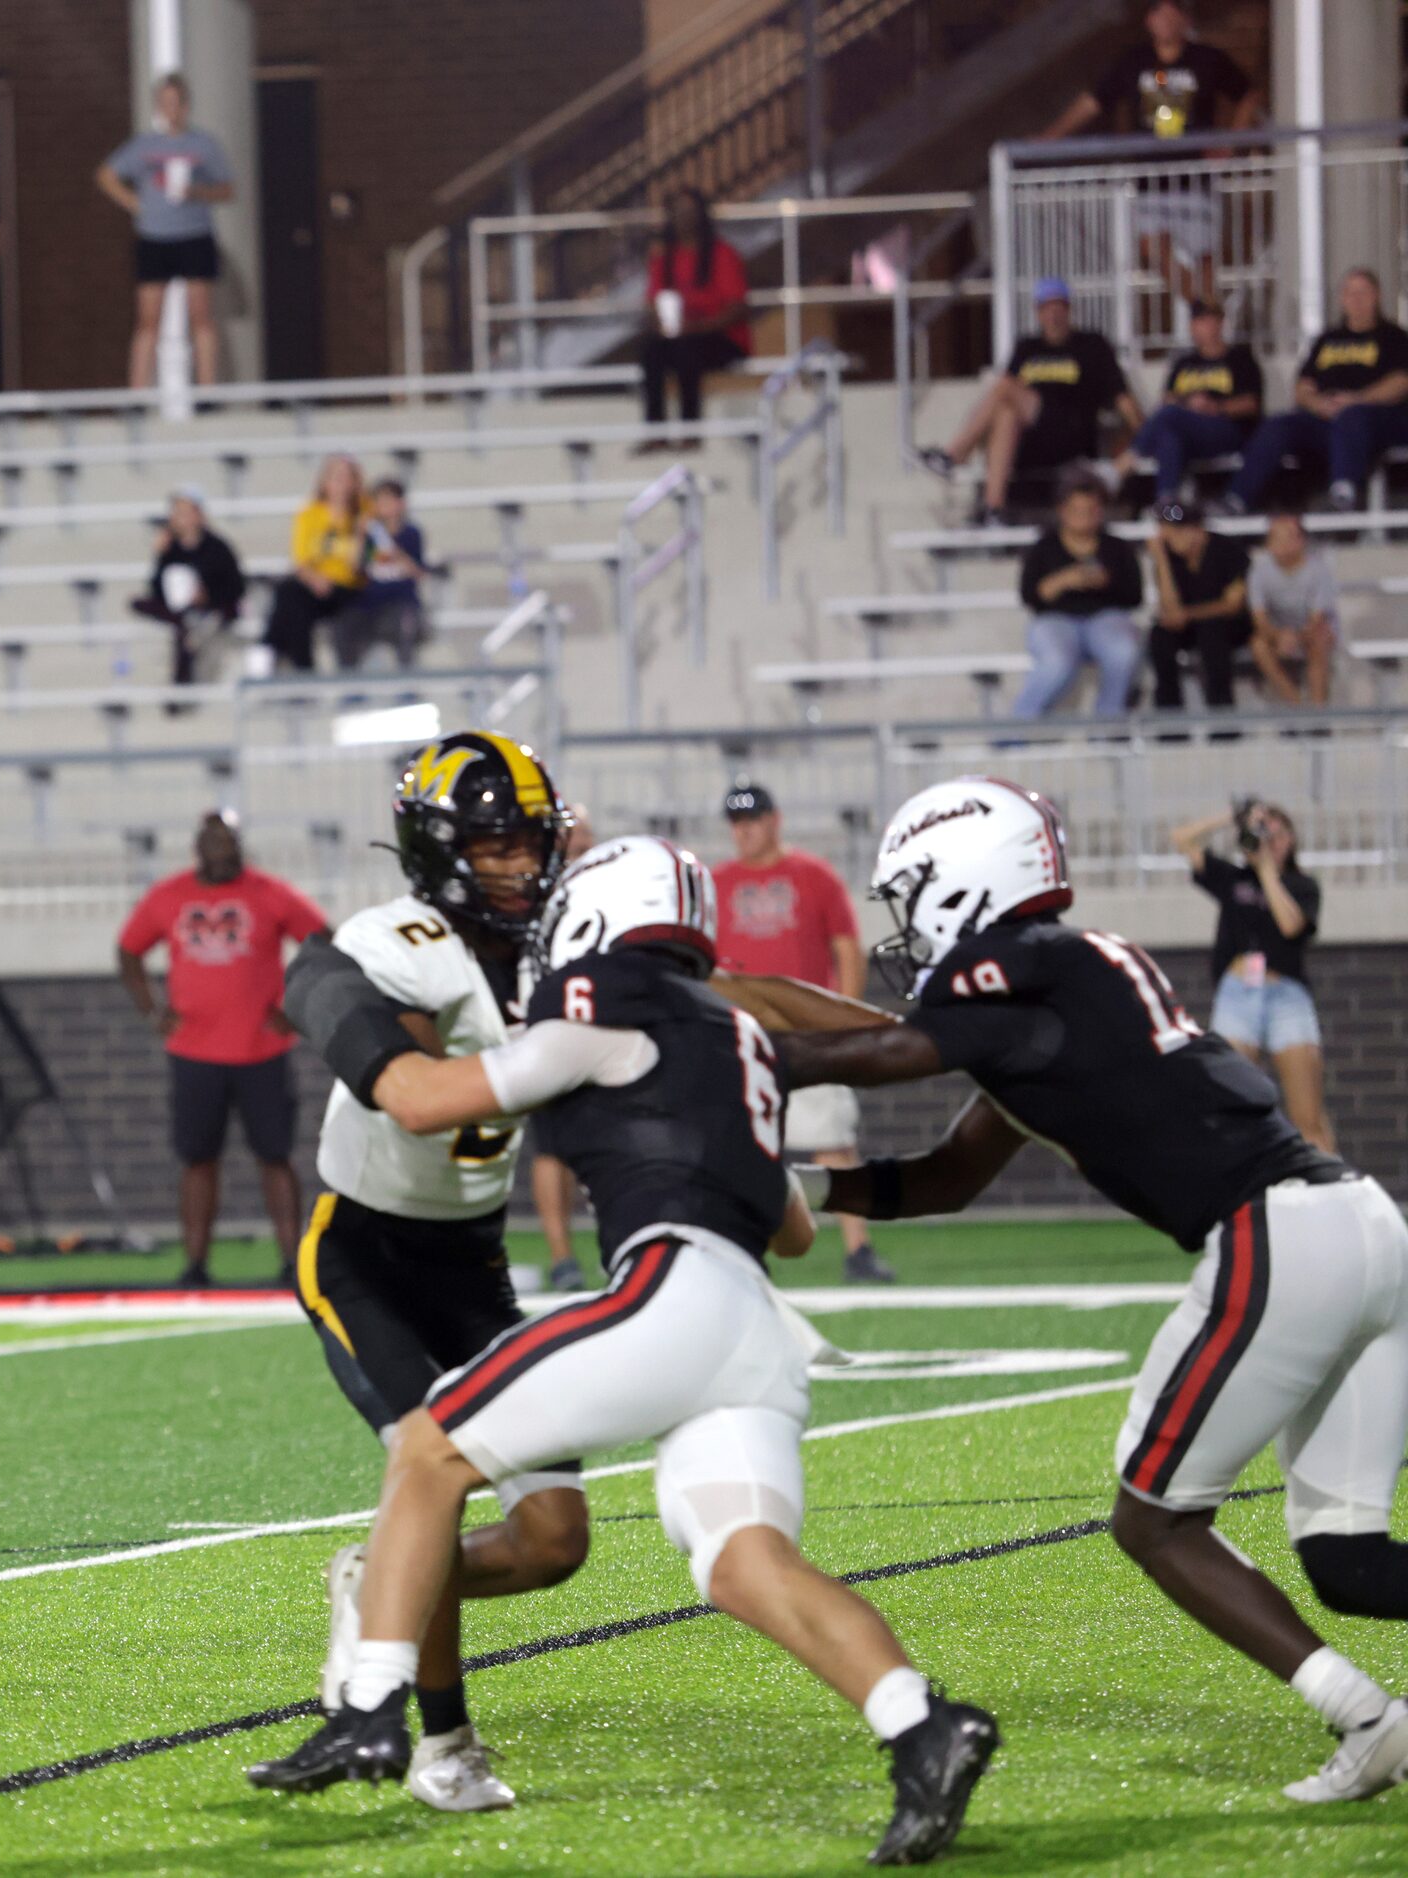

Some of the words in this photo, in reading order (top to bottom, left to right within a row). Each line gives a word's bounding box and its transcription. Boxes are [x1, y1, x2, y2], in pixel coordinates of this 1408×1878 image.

[395, 745, 486, 812] M
[395, 914, 450, 948] 2
[564, 975, 595, 1024] 6
[729, 1005, 783, 1163] 6
